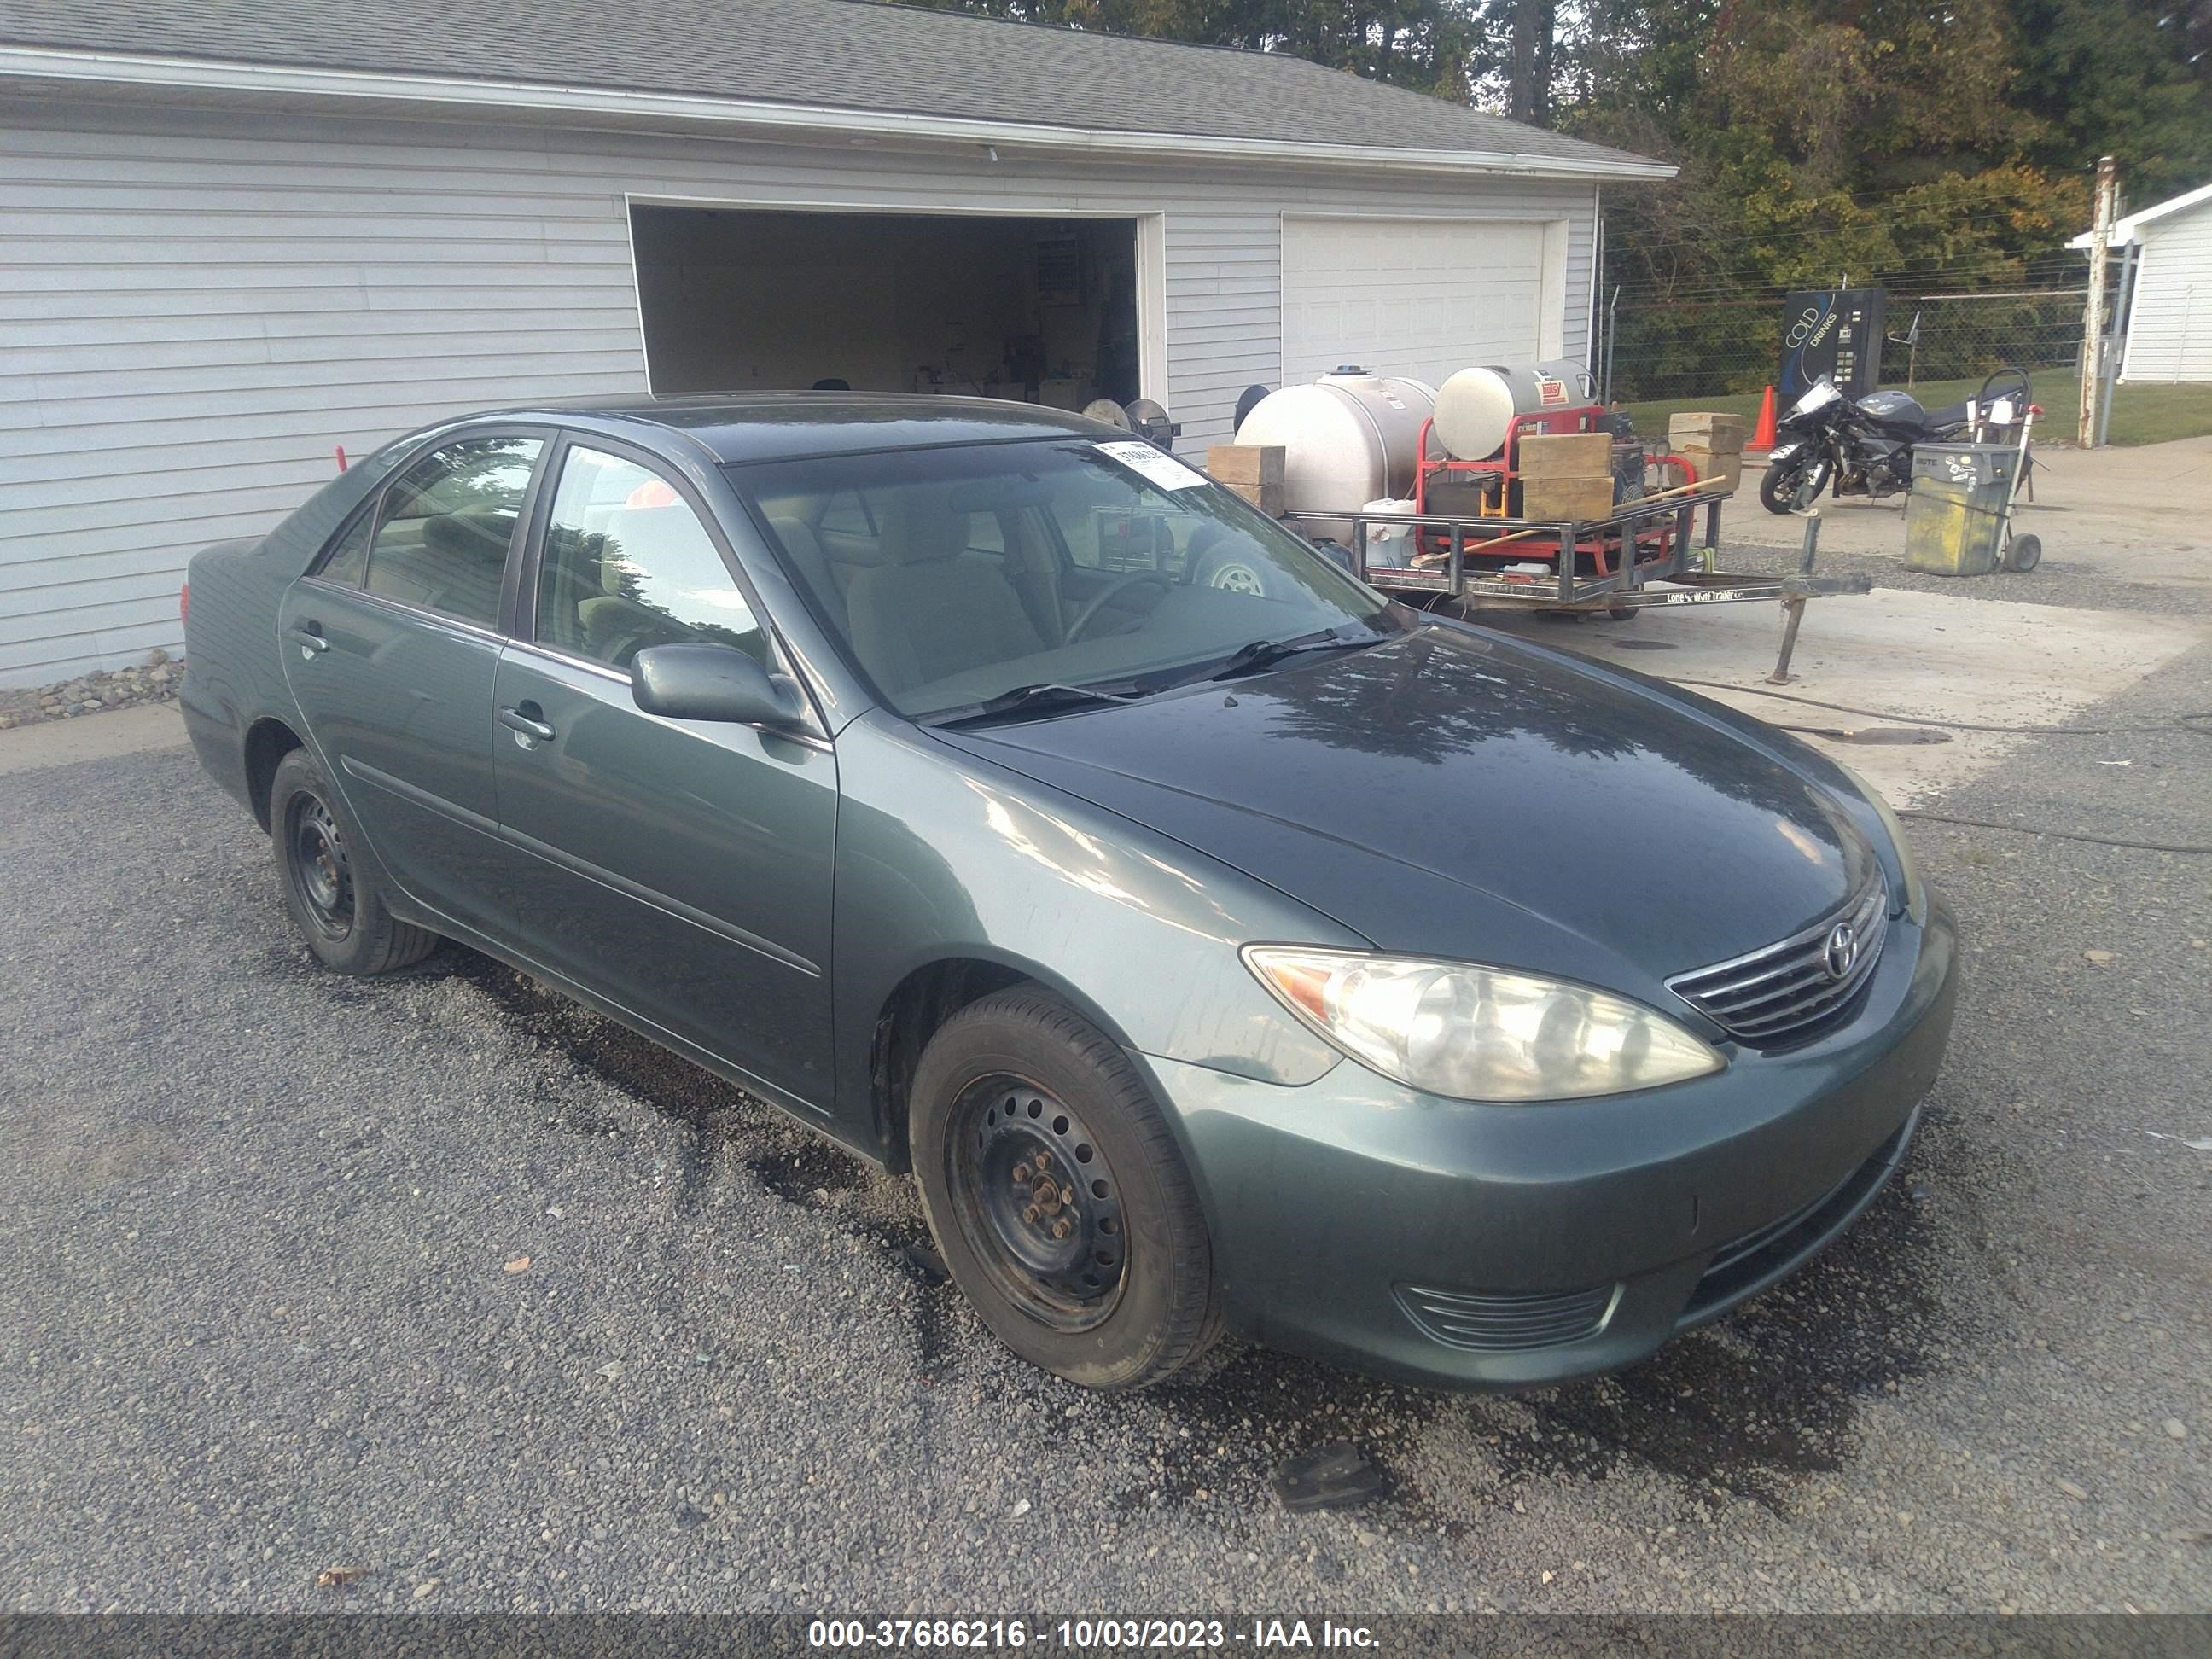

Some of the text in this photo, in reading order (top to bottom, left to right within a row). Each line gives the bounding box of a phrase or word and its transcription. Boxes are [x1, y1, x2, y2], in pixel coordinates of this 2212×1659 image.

[1786, 307, 1819, 348] COLD
[1810, 312, 1837, 347] DRINKS
[1667, 593, 1685, 603] Lone
